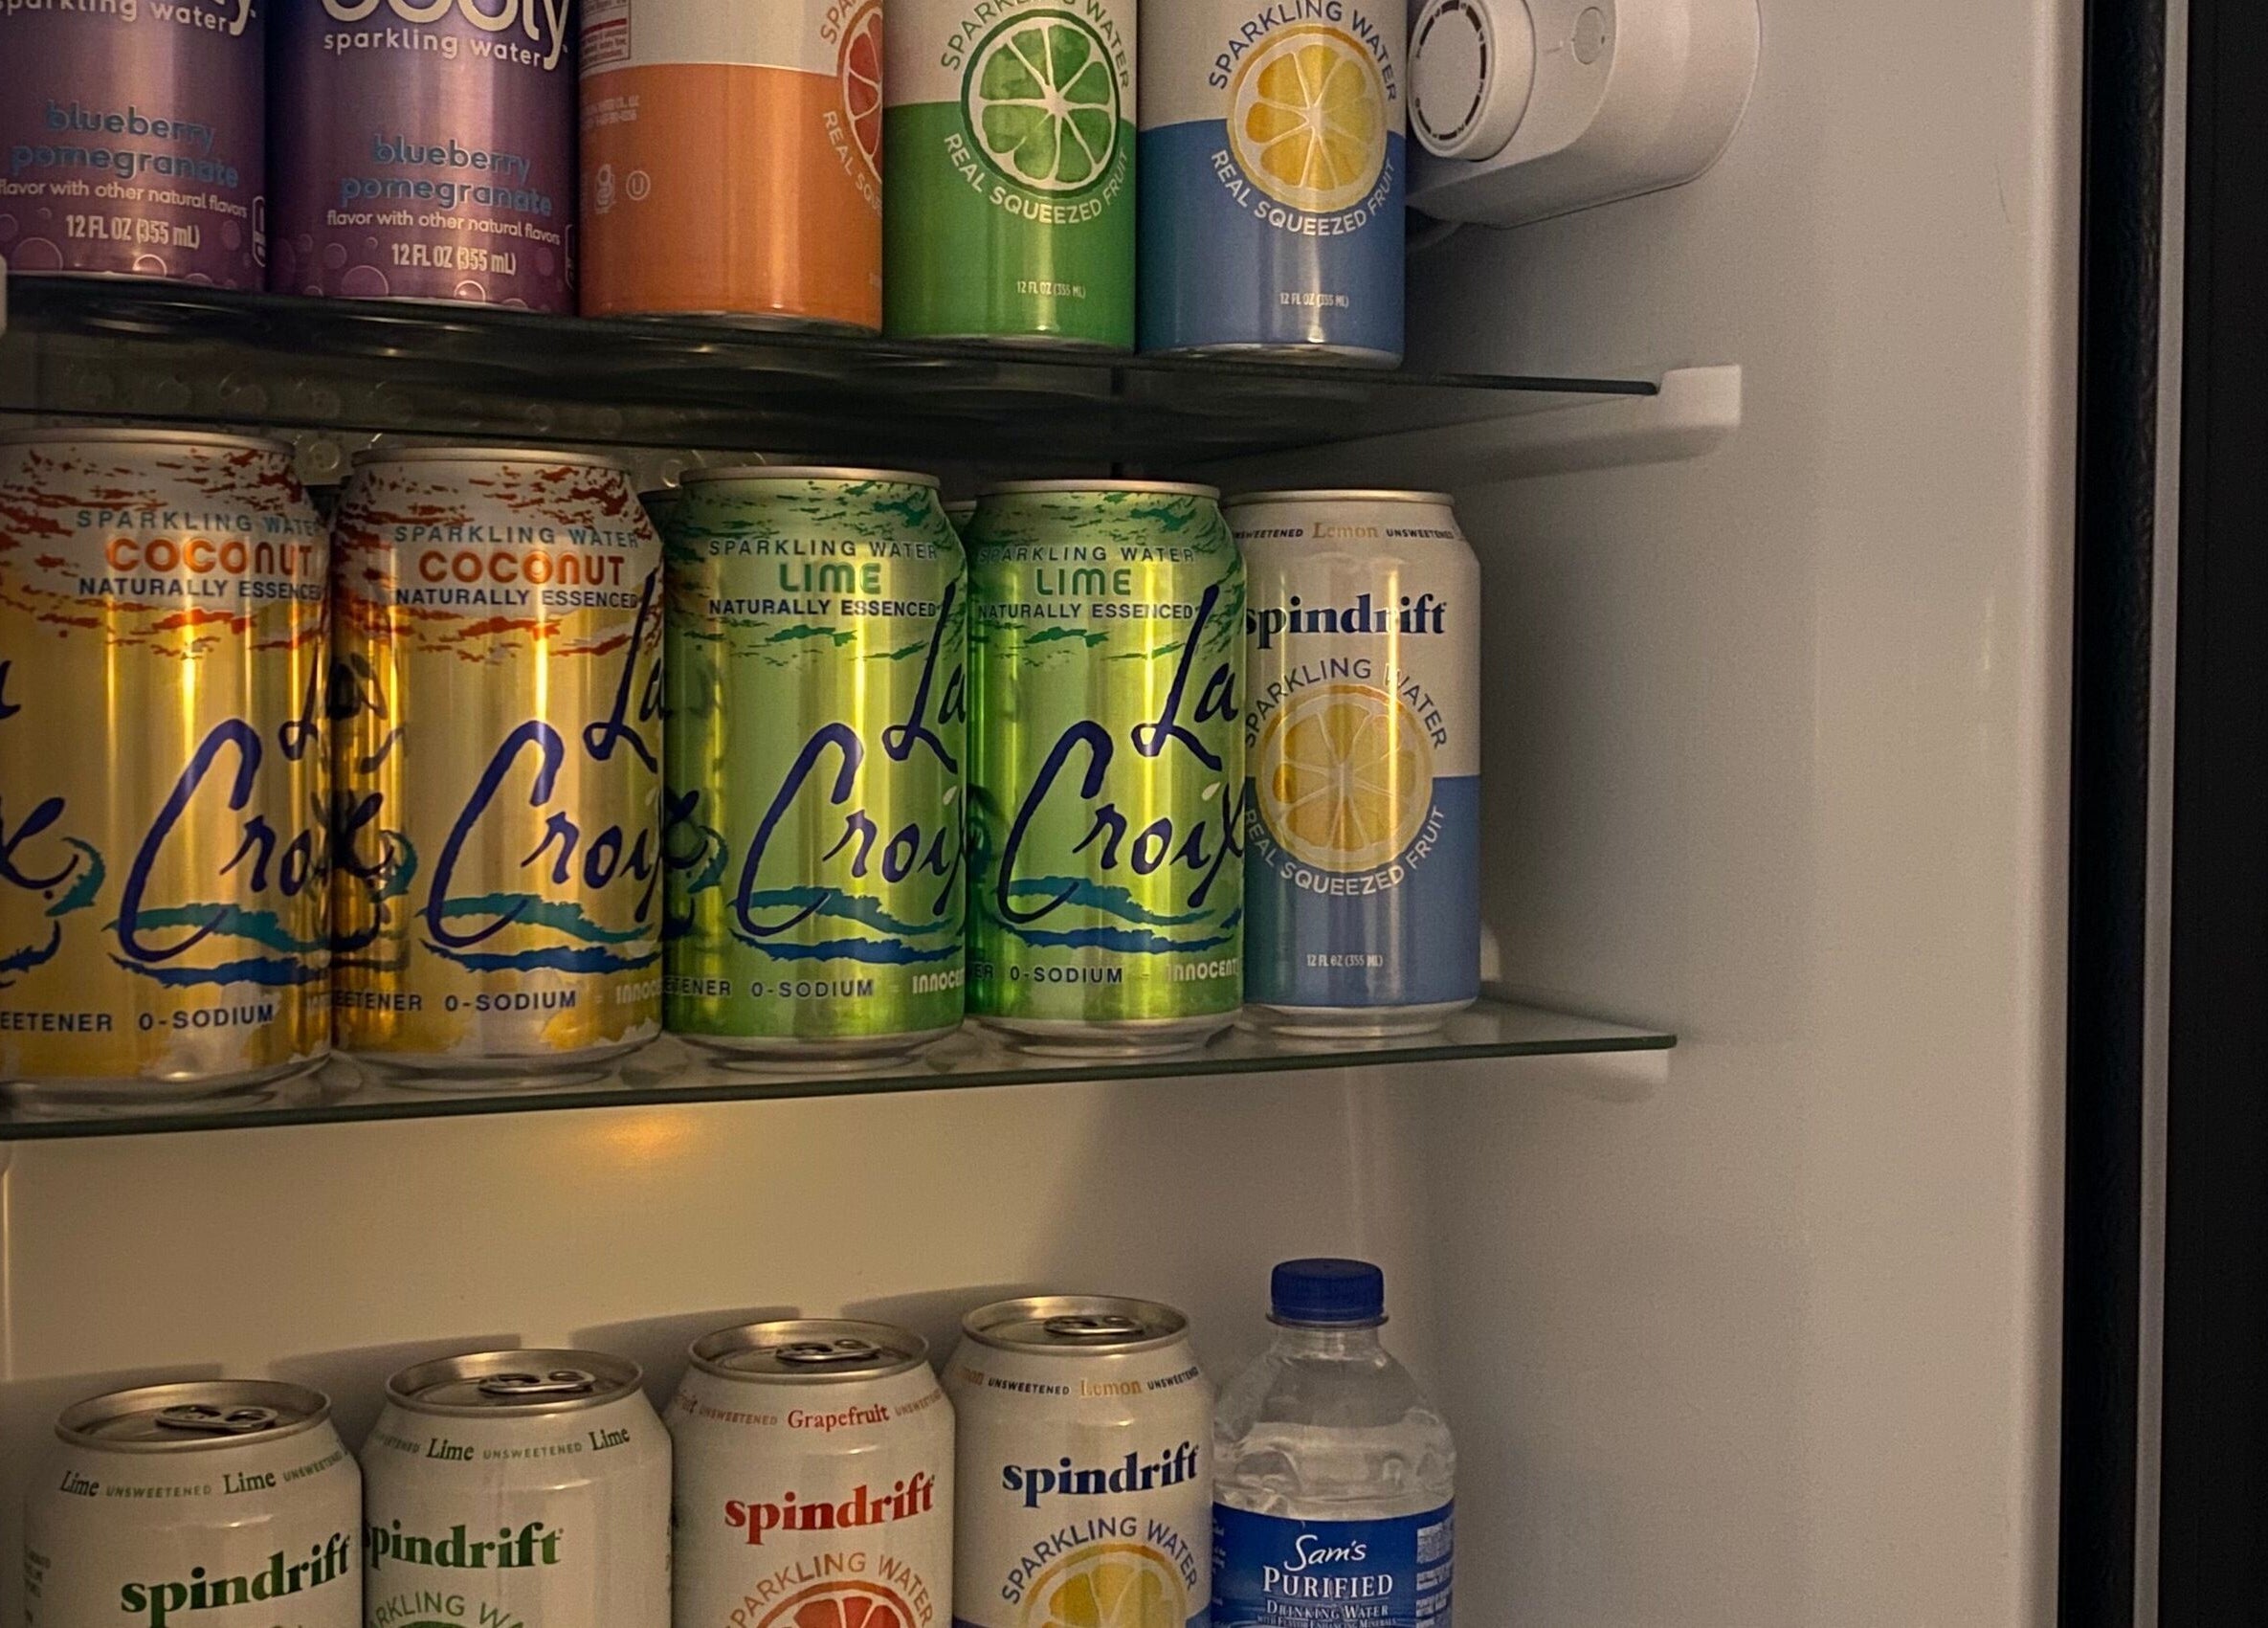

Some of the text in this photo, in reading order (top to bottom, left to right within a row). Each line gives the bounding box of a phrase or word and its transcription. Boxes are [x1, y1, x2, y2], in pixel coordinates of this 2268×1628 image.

[150, 0, 226, 32] water
[324, 28, 541, 67] sparkling water
[1084, 0, 1129, 88] WATER
[1209, 0, 1343, 89] SPARKLING
[1351, 9, 1397, 100] WATER
[46, 100, 215, 152] blueberry
[823, 110, 854, 176] REAL
[11, 145, 238, 189] pomegranate
[372, 134, 530, 184] blueberry
[944, 133, 983, 192] REAL
[989, 186, 1101, 224] SQUEEZED
[1102, 148, 1127, 206] FRUIT
[1212, 149, 1394, 236] REAL SQUEEZED FRUIT
[50, 180, 89, 196] with
[96, 180, 142, 200] other
[148, 188, 206, 209] natural
[209, 195, 247, 218] flavors
[342, 178, 552, 217] pomegranate
[66, 214, 200, 250] 12 FL OZ (355 mL)
[327, 210, 561, 246] flavor with other natural flavors
[392, 243, 517, 276] 12 FL OZ (355 mL)
[1016, 280, 1027, 294] 12
[1039, 281, 1052, 296] OZ
[1279, 292, 1290, 304] 12
[1303, 293, 1315, 306] OZ
[77, 510, 253, 532] SPARKLING
[394, 526, 639, 548] SPARKLING WATER
[1312, 522, 1378, 539] Lemon
[106, 536, 313, 575] COCONUT
[419, 549, 625, 586] COCONUT
[708, 539, 937, 560] SPARKLING WATER
[978, 546, 1194, 563] SPARKLING WATER
[78, 578, 229, 596] NATURALLY
[779, 562, 881, 595] LIME
[1035, 568, 1131, 596] LIME
[395, 589, 639, 609] NATURALLY ESSENCED
[709, 599, 937, 617] NATURALLY ESSENCED
[978, 603, 1193, 619] NATURALLY ESSENCED
[881, 580, 966, 774] La
[1131, 584, 1238, 771] La
[1245, 658, 1447, 749] SPARKLING WATER
[998, 721, 1244, 924] Croix
[1244, 805, 1444, 896] REAL SQUEEZED FRUIT
[1010, 965, 1123, 984] 0-SODIUM
[1307, 954, 1316, 967] 12
[445, 991, 576, 1013] 0-SODIUM
[750, 978, 874, 997] 0-SODIUM
[0, 1004, 274, 1032] EETENER 0-SODIUM
[989, 1378, 1070, 1395] UNSWEETENED
[1080, 1378, 1142, 1396] Lemon
[788, 1403, 890, 1432] Grapefruit
[426, 1438, 475, 1461] Lime
[483, 1442, 582, 1460] UNSWEETENED
[589, 1426, 631, 1452] Lime
[60, 1470, 100, 1497] Lime
[106, 1484, 211, 1498] UNSWEETENED
[223, 1471, 277, 1495] Lime
[1002, 1440, 1199, 1508] spindrift
[724, 1471, 935, 1546] spindrift
[1002, 1516, 1137, 1605] SPARKLING
[1147, 1519, 1195, 1593] WATER
[1284, 1534, 1367, 1572] Sam's
[121, 1532, 350, 1628] spindrift
[727, 1551, 933, 1628] PARKLING WATER
[1262, 1565, 1393, 1598] PURIFIED
